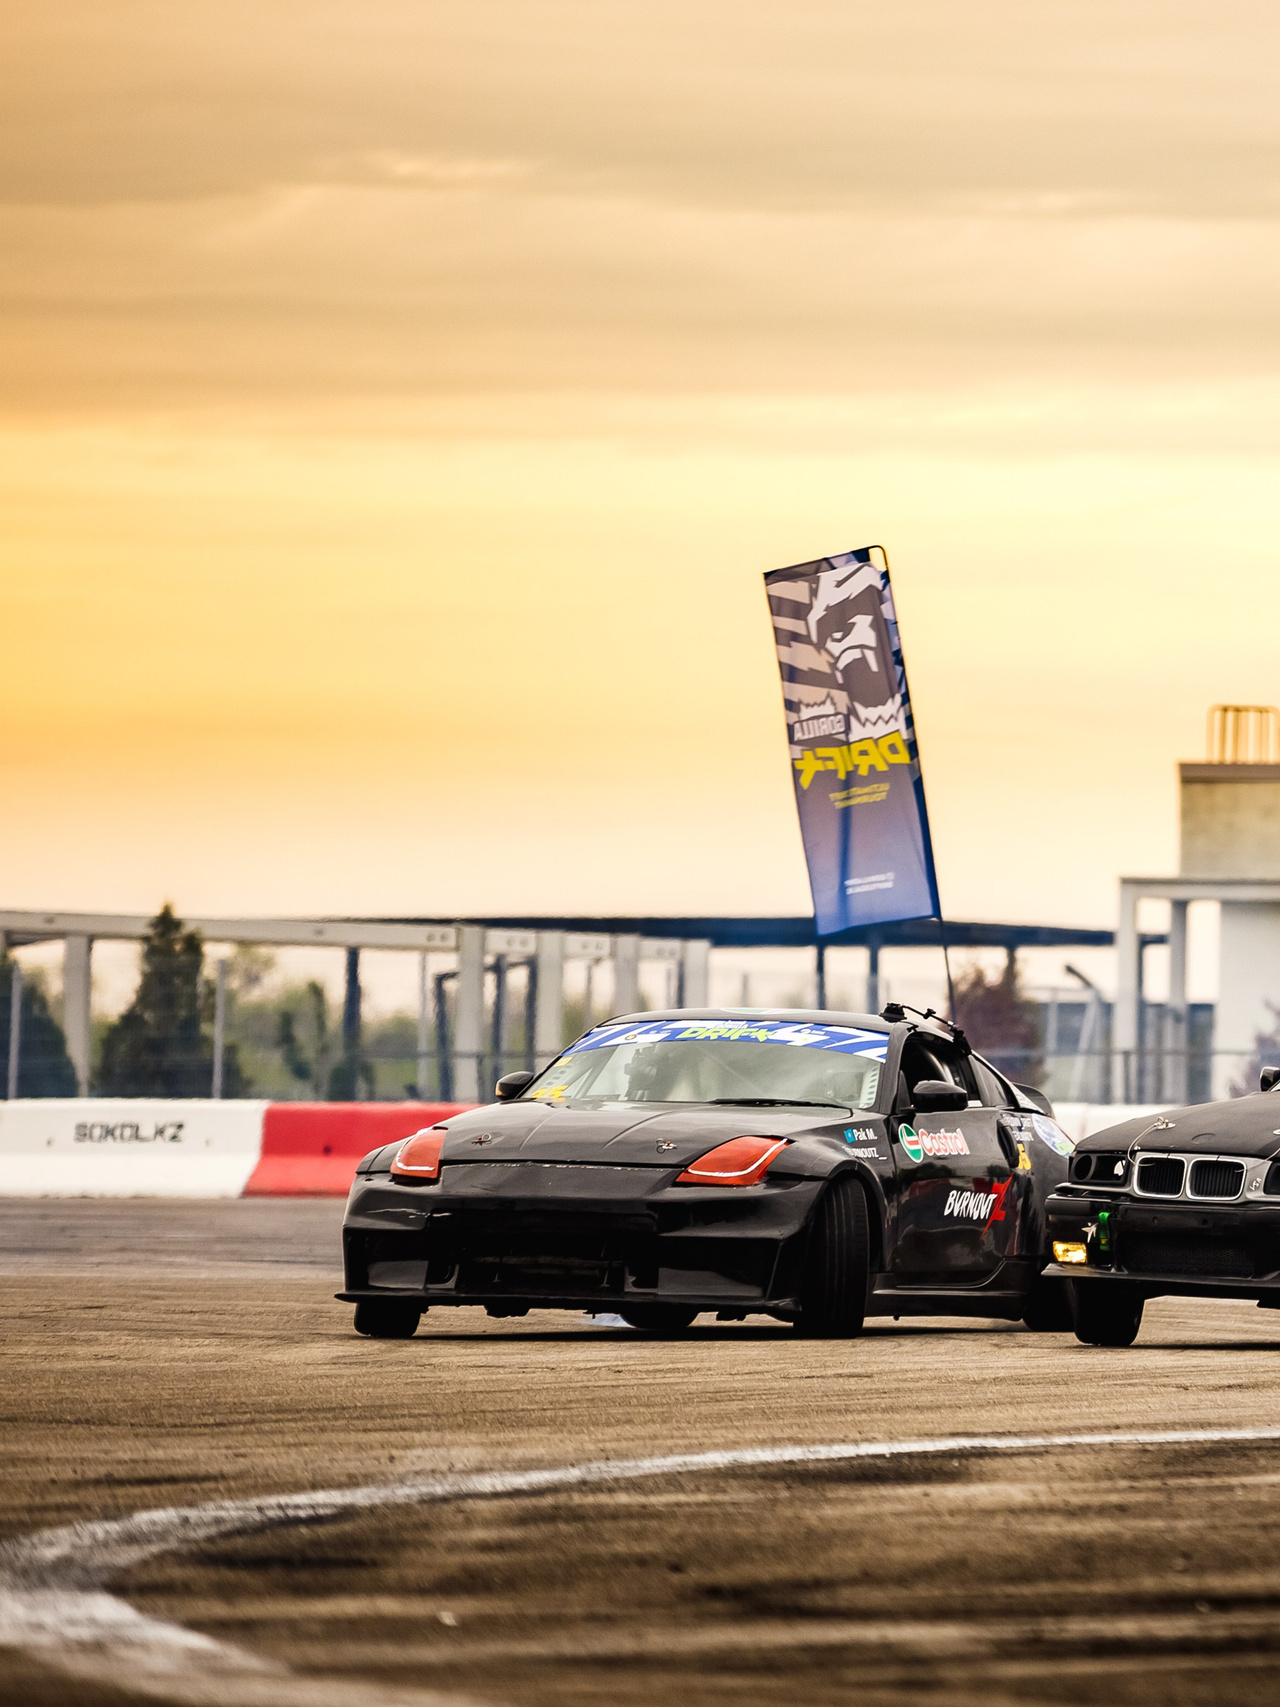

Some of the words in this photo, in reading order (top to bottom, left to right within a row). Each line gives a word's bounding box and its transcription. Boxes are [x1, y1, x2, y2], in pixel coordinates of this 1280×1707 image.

[675, 1027, 774, 1042] DRIFT
[852, 1128, 867, 1141] Pak
[918, 1128, 970, 1156] Castrol
[1017, 1143, 1032, 1170] 5
